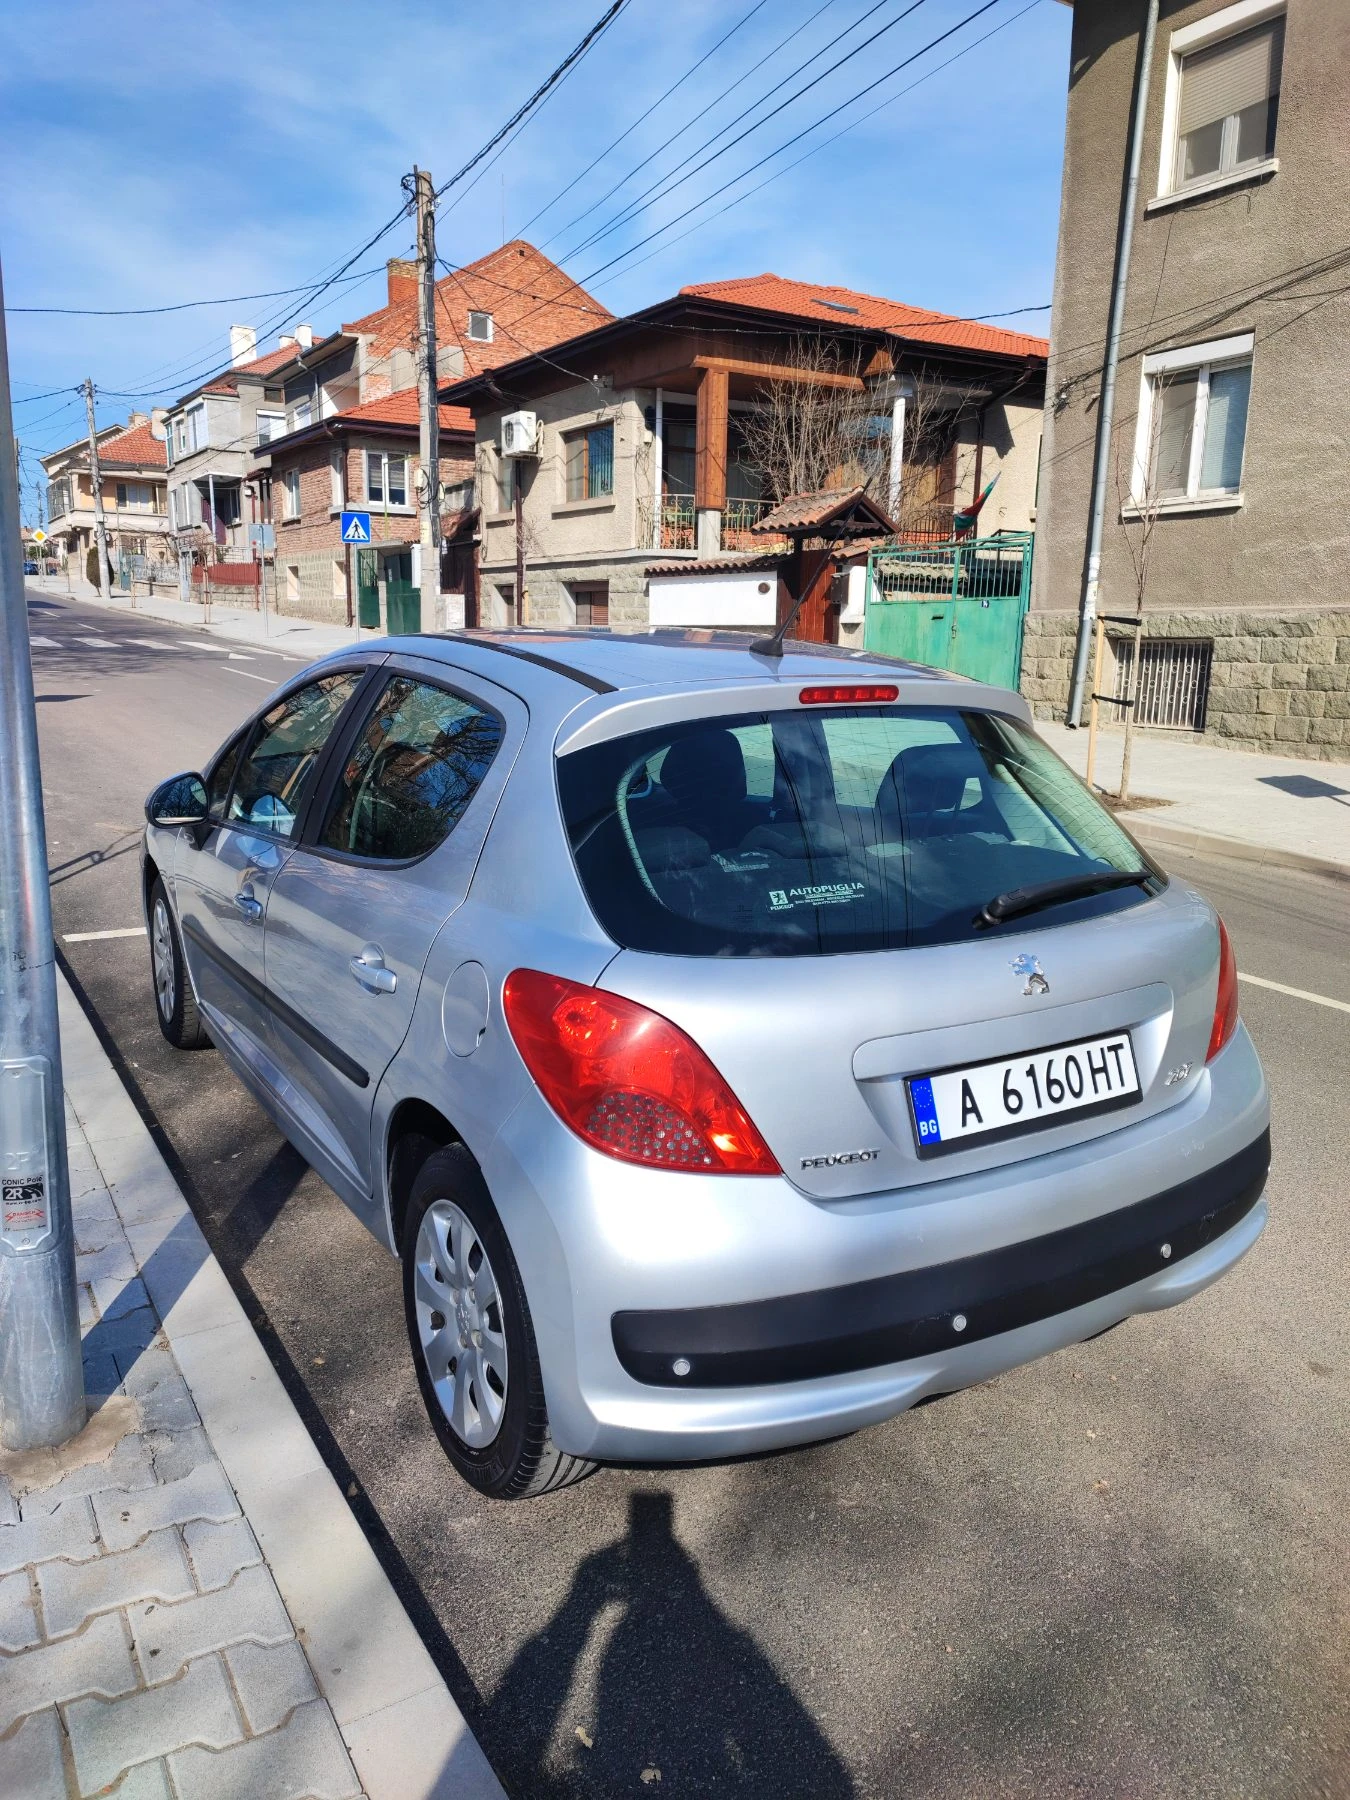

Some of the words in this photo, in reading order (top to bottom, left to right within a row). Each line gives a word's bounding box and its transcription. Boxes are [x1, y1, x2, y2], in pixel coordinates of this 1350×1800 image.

[789, 882, 865, 896] AUTOPUGLIA
[961, 1078, 984, 1128] A
[919, 1119, 938, 1137] BG
[800, 1149, 881, 1170] PEUGEOT
[5, 1188, 23, 1199] 2R
